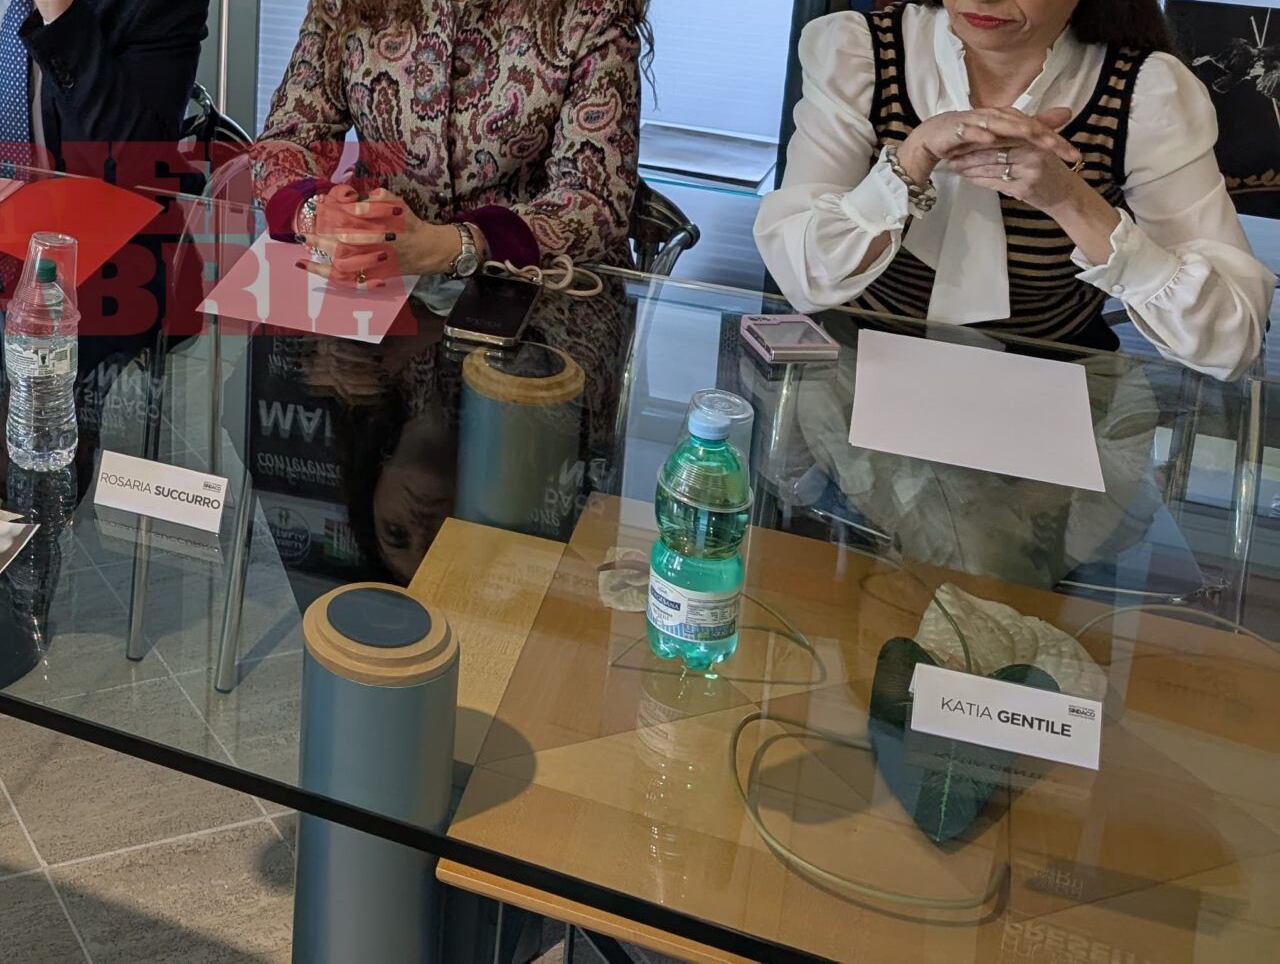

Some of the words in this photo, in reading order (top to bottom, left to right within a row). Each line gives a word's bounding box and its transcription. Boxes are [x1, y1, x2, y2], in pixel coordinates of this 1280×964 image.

[100, 472, 152, 495] ROSARIA
[154, 485, 221, 510] SUCCURRO
[941, 697, 993, 720] KATIA
[997, 710, 1072, 737] GENTILE
